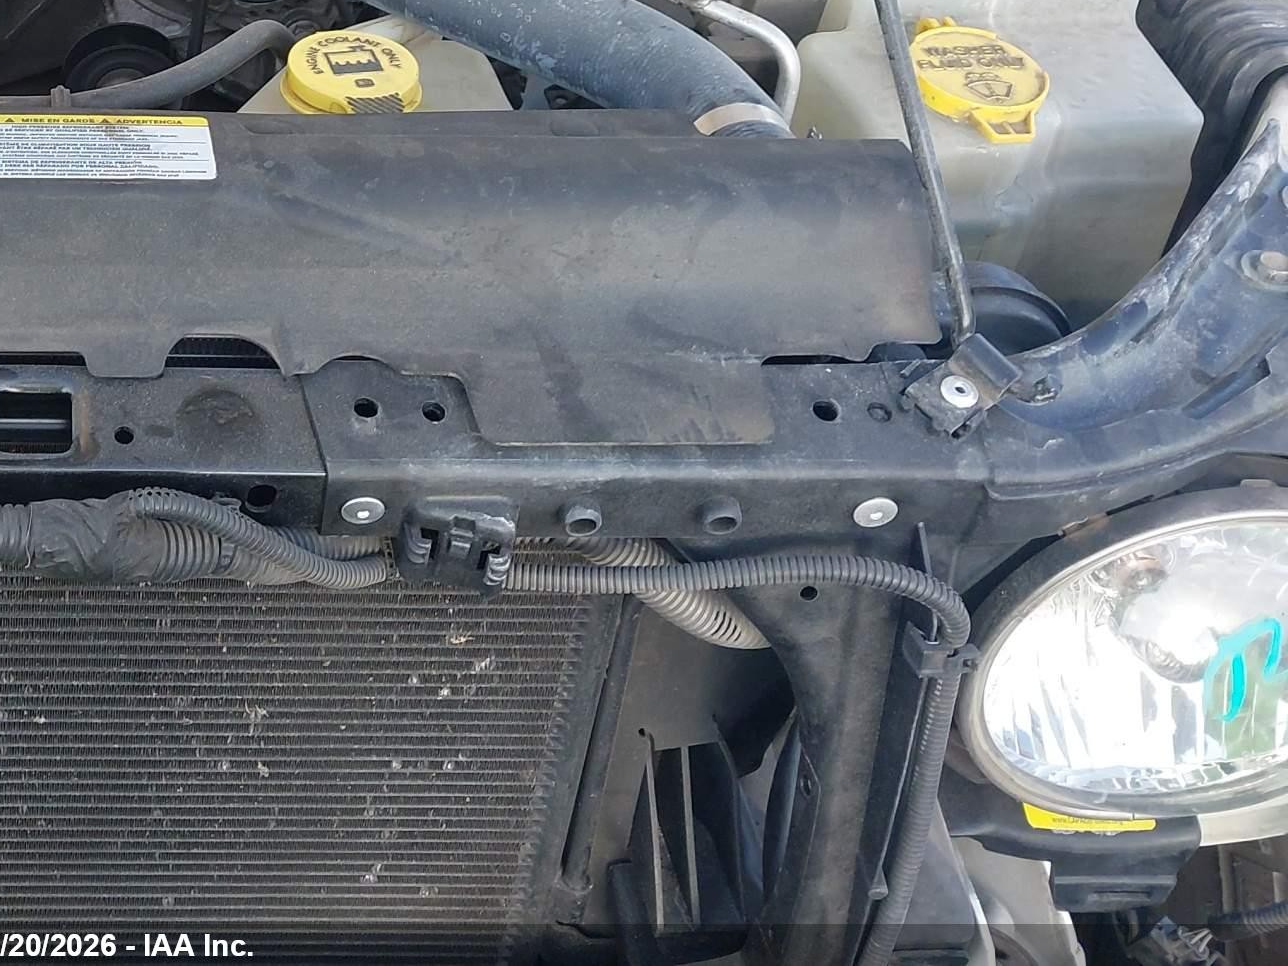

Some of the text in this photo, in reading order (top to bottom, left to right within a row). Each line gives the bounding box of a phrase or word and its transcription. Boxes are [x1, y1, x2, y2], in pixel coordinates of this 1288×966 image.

[306, 36, 402, 75] ENGINE COOLANT ONLY
[921, 45, 1007, 57] WASHER
[917, 57, 973, 69] FLUID
